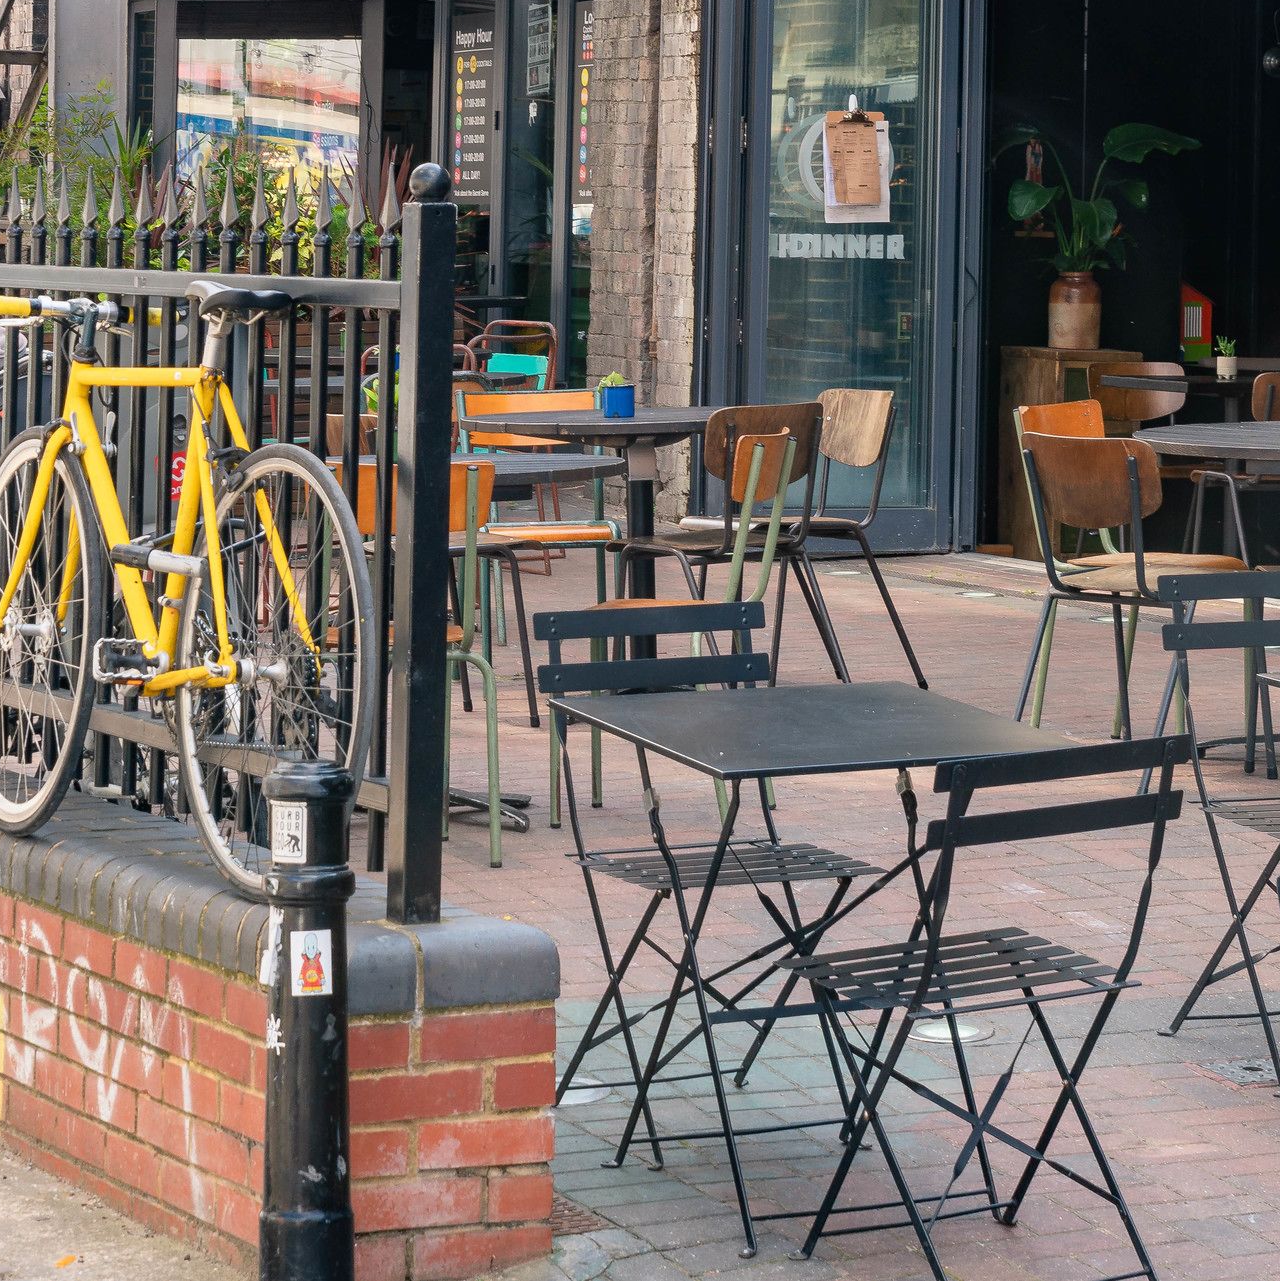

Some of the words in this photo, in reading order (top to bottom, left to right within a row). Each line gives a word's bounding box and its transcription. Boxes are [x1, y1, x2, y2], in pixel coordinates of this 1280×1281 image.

[455, 30, 476, 48] Happy
[476, 28, 493, 44] Hour
[461, 170, 470, 180] ALL
